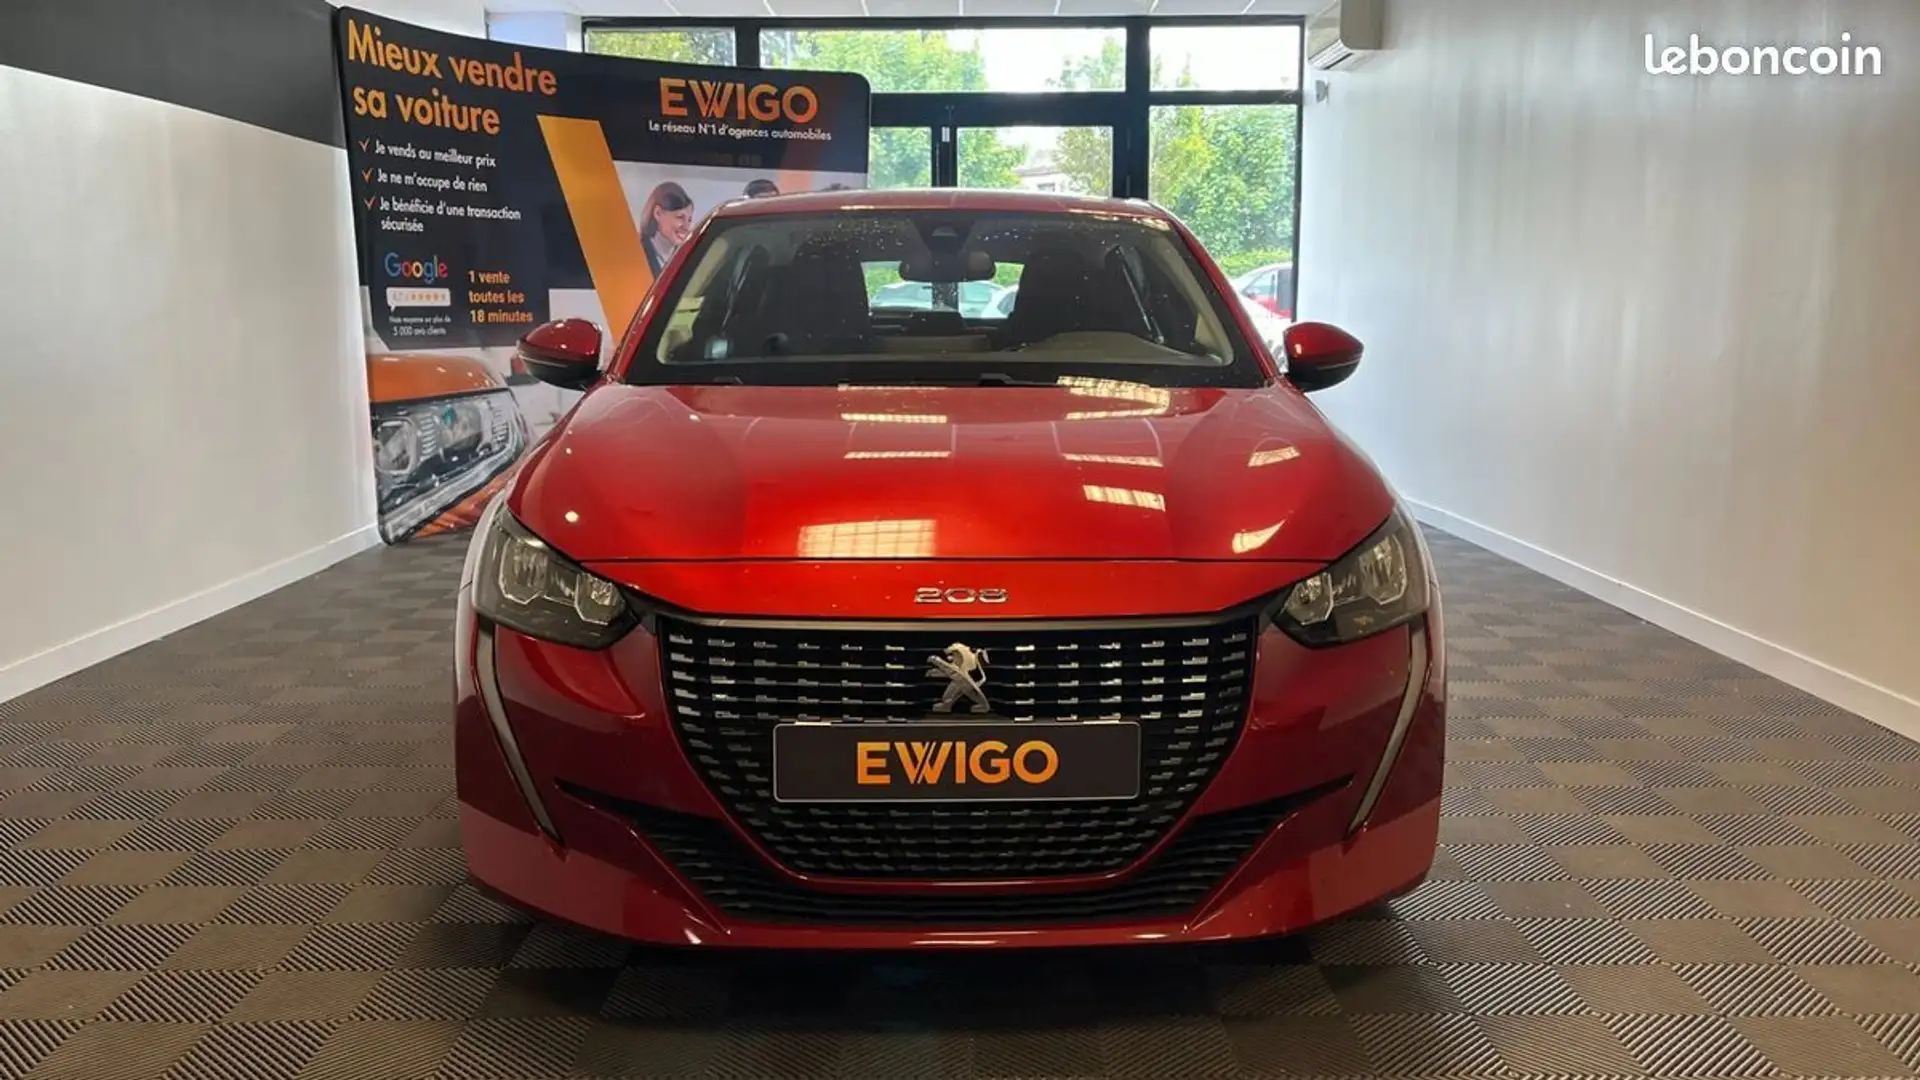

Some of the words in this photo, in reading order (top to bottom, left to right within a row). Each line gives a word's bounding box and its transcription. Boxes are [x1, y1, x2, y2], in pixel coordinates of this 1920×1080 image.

[348, 19, 443, 79] Mieux
[448, 52, 558, 96] vendre
[353, 86, 388, 118] sa
[395, 88, 501, 136] voiture
[659, 78, 818, 123] EWIGO
[648, 120, 662, 132] Le
[662, 122, 696, 134] réseau
[718, 124, 769, 139] d'agences
[772, 129, 832, 141] automobiles
[375, 140, 386, 154] Je
[387, 143, 417, 159] vends
[418, 149, 432, 161] au
[433, 148, 473, 165] meilleur
[475, 154, 497, 169] prix
[377, 169, 388, 183] Je
[390, 174, 403, 184] ne
[404, 173, 451, 191] m'occupe
[453, 175, 466, 190] de
[468, 178, 487, 192] rien
[379, 196, 390, 212] Je
[392, 196, 434, 215] bénéficie
[436, 201, 465, 216] d'une
[467, 205, 521, 221] transaction
[381, 217, 424, 233] sécurisée
[385, 252, 448, 284] Google
[468, 270, 476, 283] 1
[479, 271, 510, 283] vente
[469, 290, 504, 304] toutes
[507, 290, 525, 304] les
[470, 309, 486, 323] 18
[488, 309, 533, 323] minutes
[914, 587, 1007, 603] 208
[856, 740, 1058, 785] EWIGO
